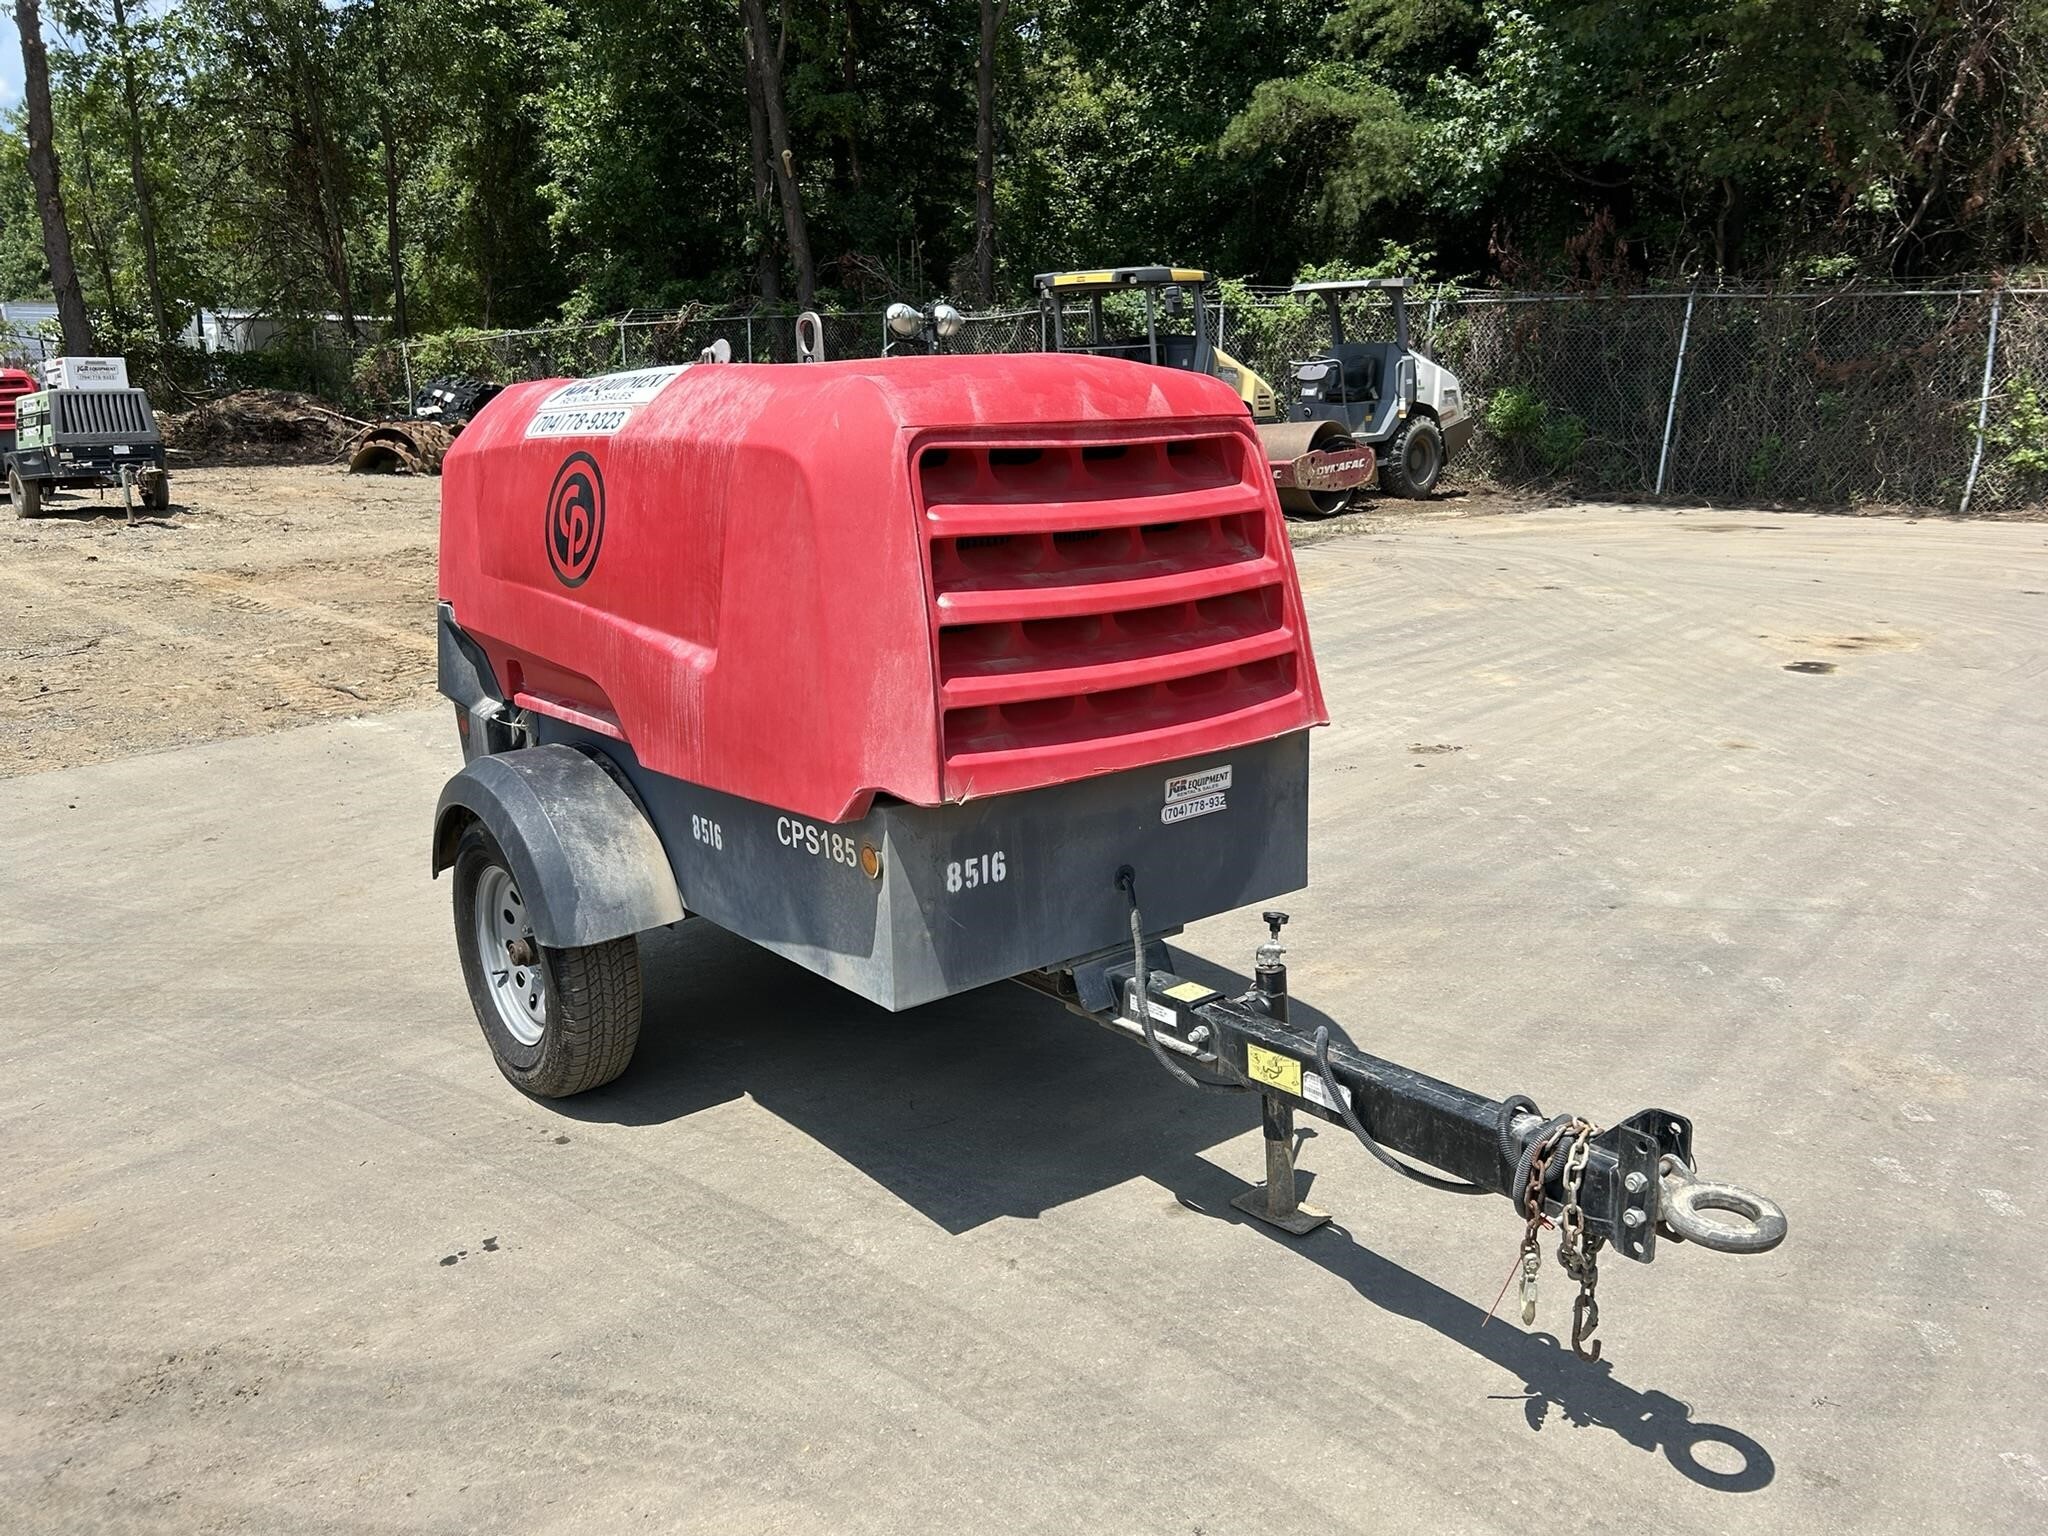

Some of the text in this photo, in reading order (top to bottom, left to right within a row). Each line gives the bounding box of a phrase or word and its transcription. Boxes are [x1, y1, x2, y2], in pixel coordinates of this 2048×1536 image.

[1188, 772, 1229, 789] EQUIPMENT
[693, 814, 722, 850] 8516
[777, 816, 857, 867] CPS185
[946, 851, 1006, 892] 8516
